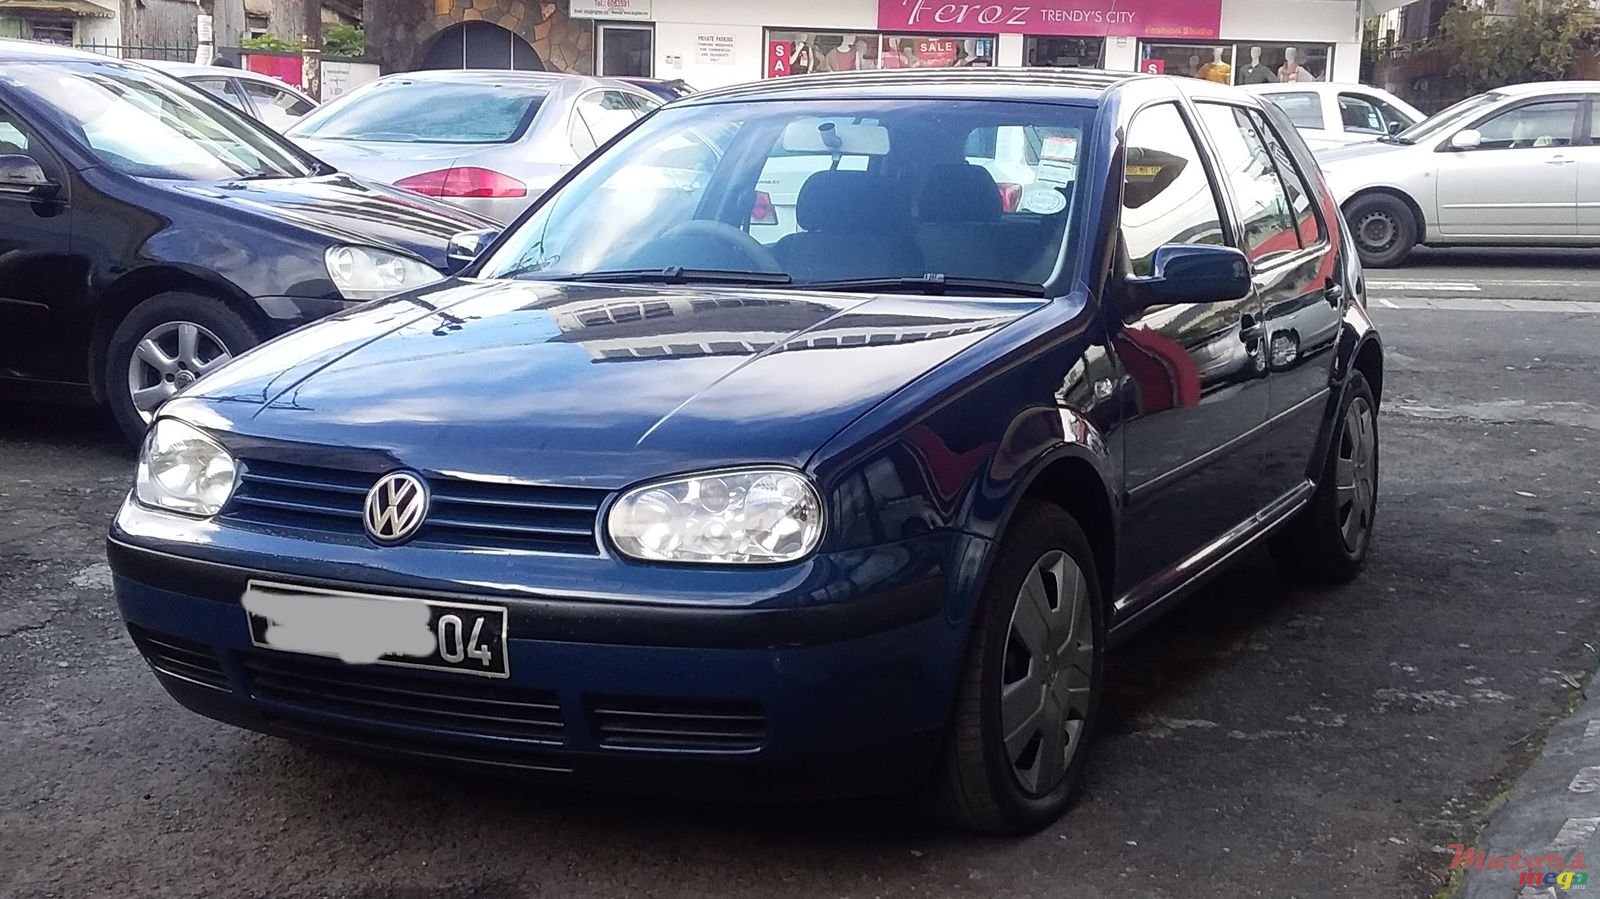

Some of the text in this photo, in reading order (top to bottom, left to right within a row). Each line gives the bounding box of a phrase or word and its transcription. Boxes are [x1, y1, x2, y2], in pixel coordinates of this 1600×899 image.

[902, 0, 1031, 25] Feroz
[1040, 9, 1135, 23] TRENDY'S CITY
[1145, 26, 1213, 36] Fashion Studio
[920, 42, 953, 52] SALE
[438, 614, 492, 667] 04
